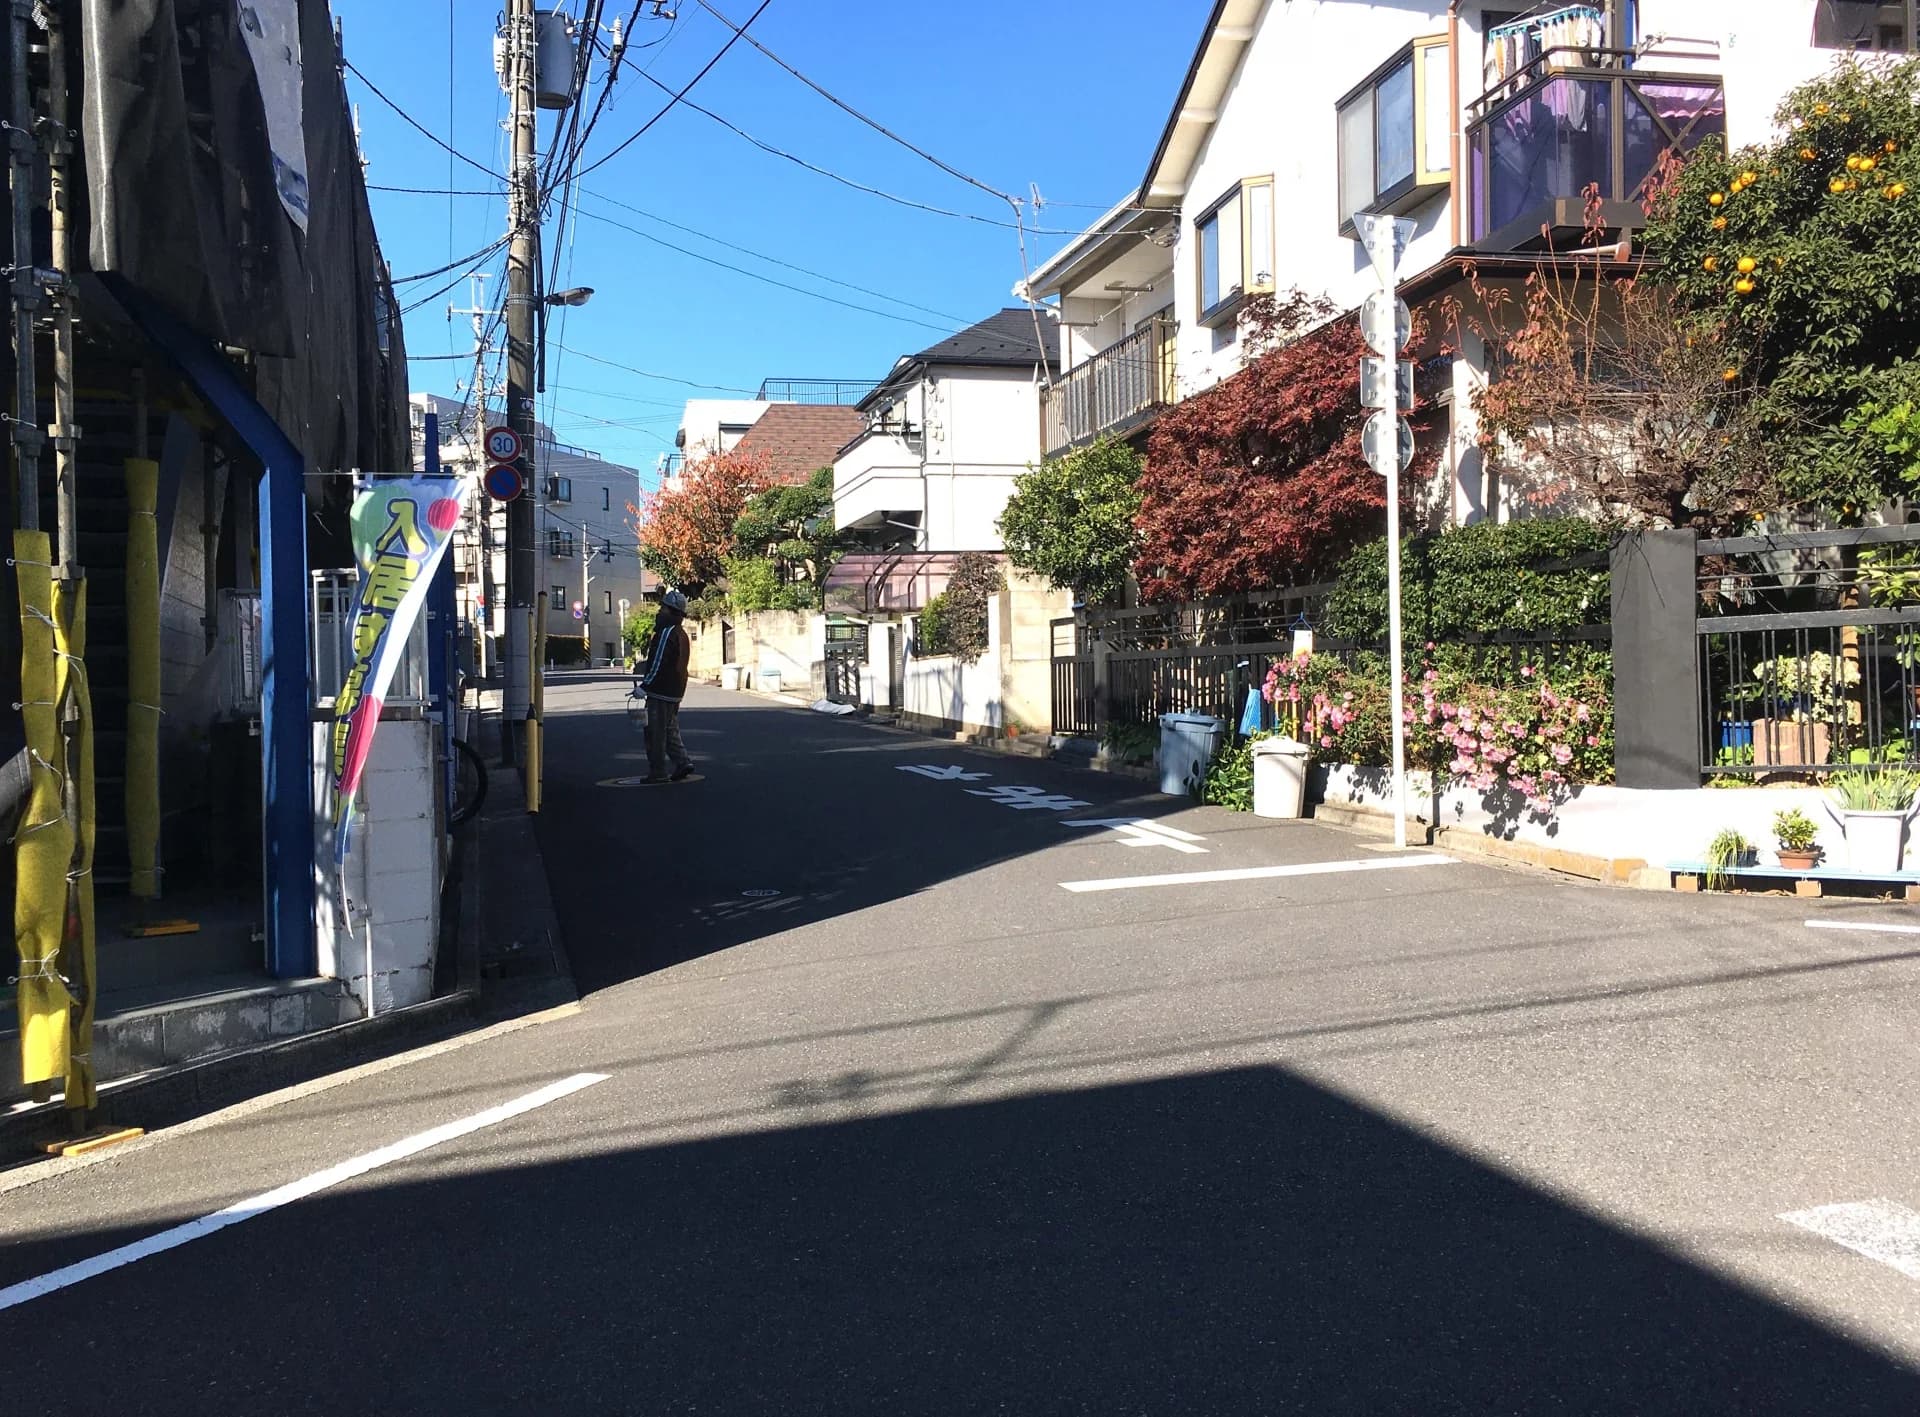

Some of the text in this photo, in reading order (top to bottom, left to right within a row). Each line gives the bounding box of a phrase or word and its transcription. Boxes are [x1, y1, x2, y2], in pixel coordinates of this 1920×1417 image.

[492, 436, 513, 453] 30
[896, 764, 1210, 853] 止まれ
